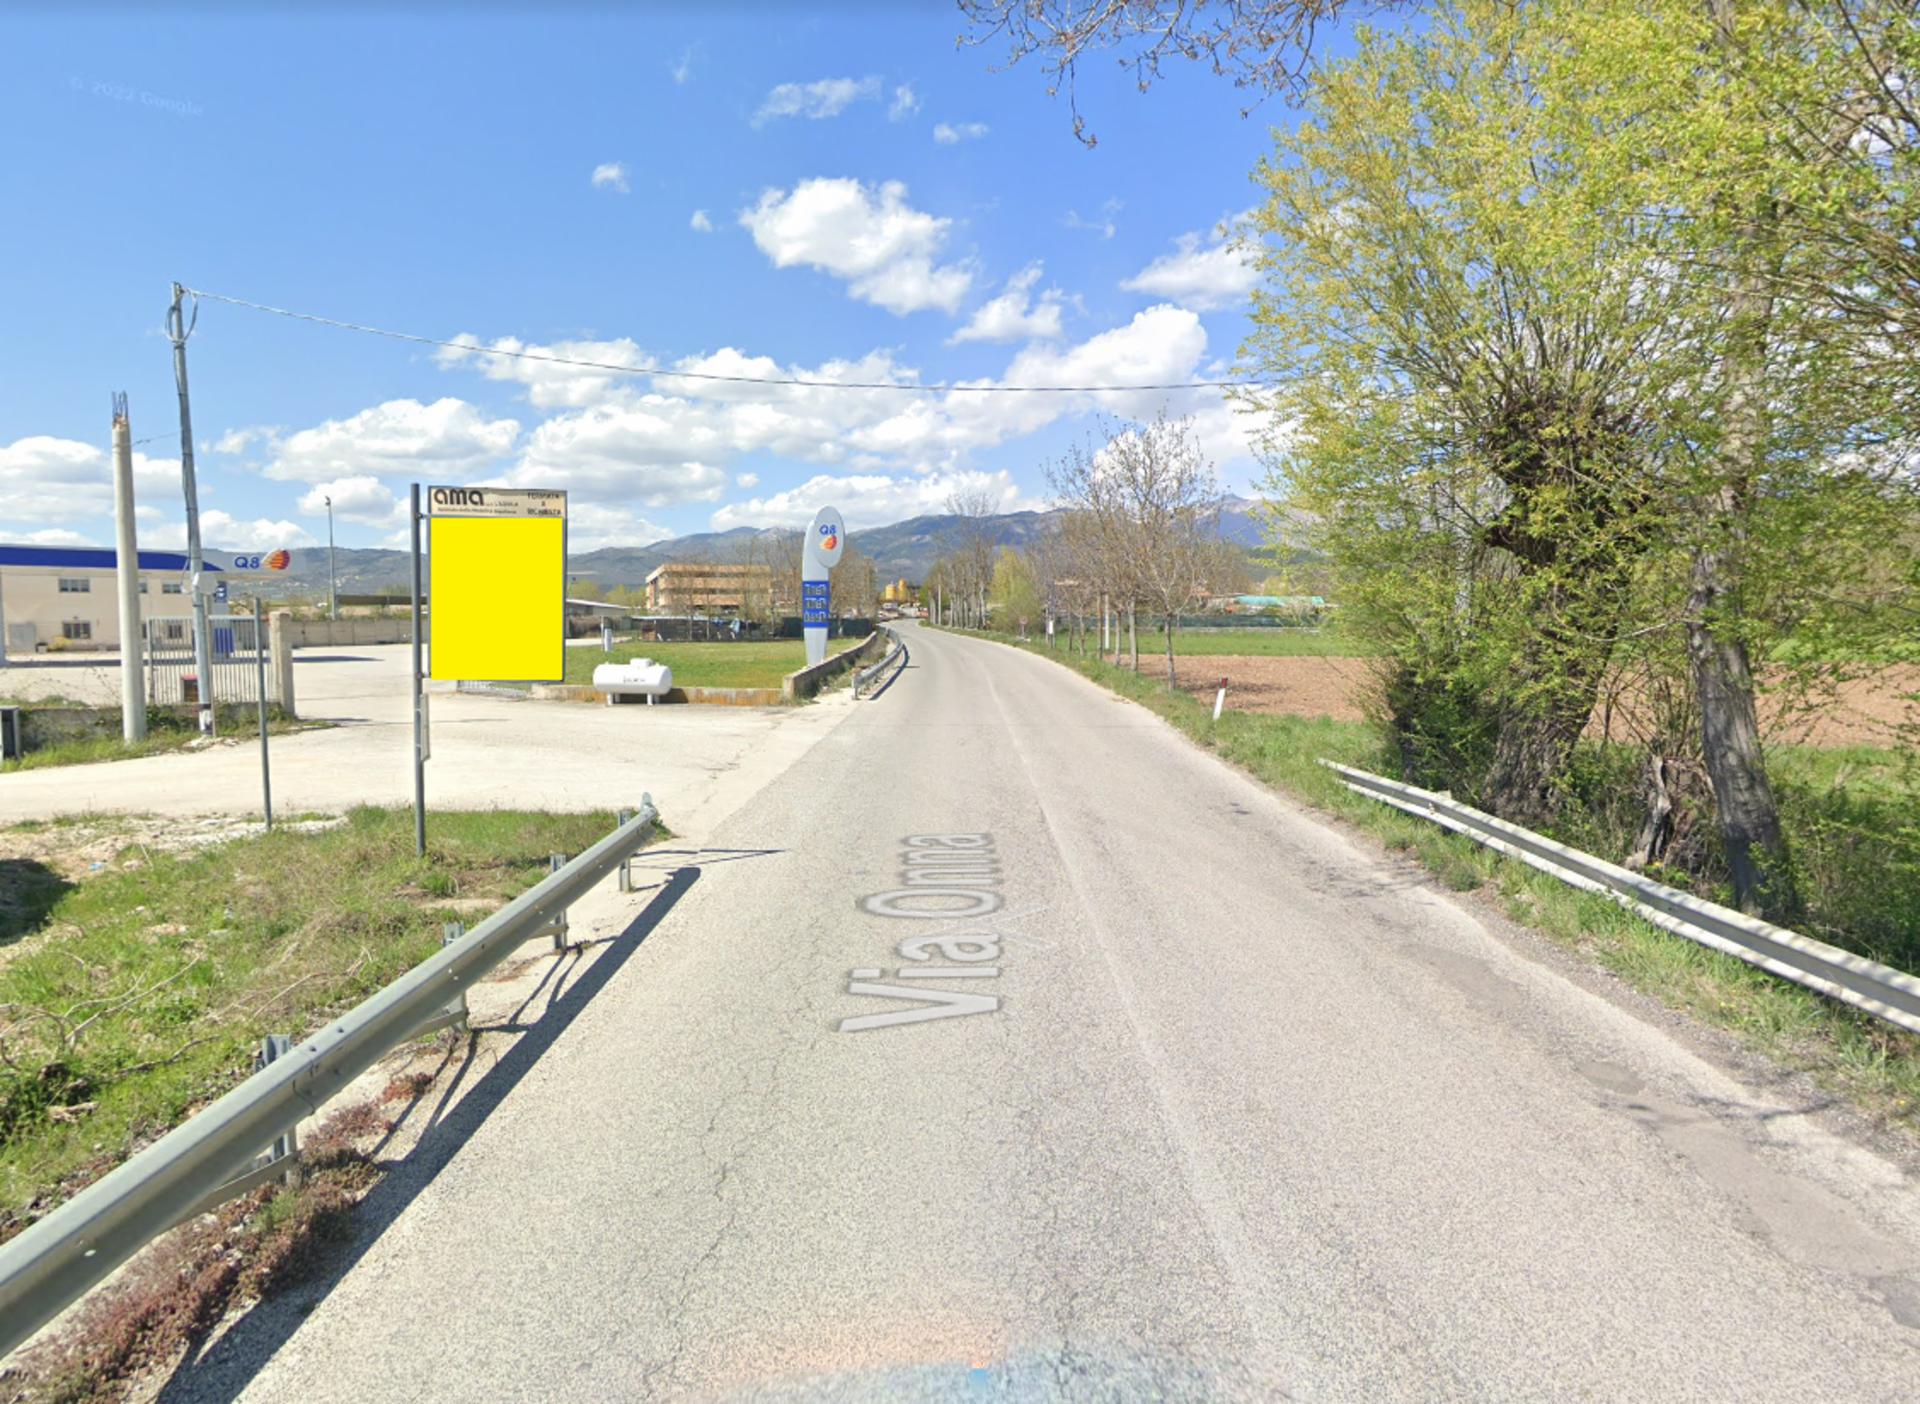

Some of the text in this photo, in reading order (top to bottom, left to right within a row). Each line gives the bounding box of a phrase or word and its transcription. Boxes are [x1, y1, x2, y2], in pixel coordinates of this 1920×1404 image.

[434, 488, 485, 506] ama
[819, 524, 837, 536] Q8
[234, 556, 260, 569] Q8
